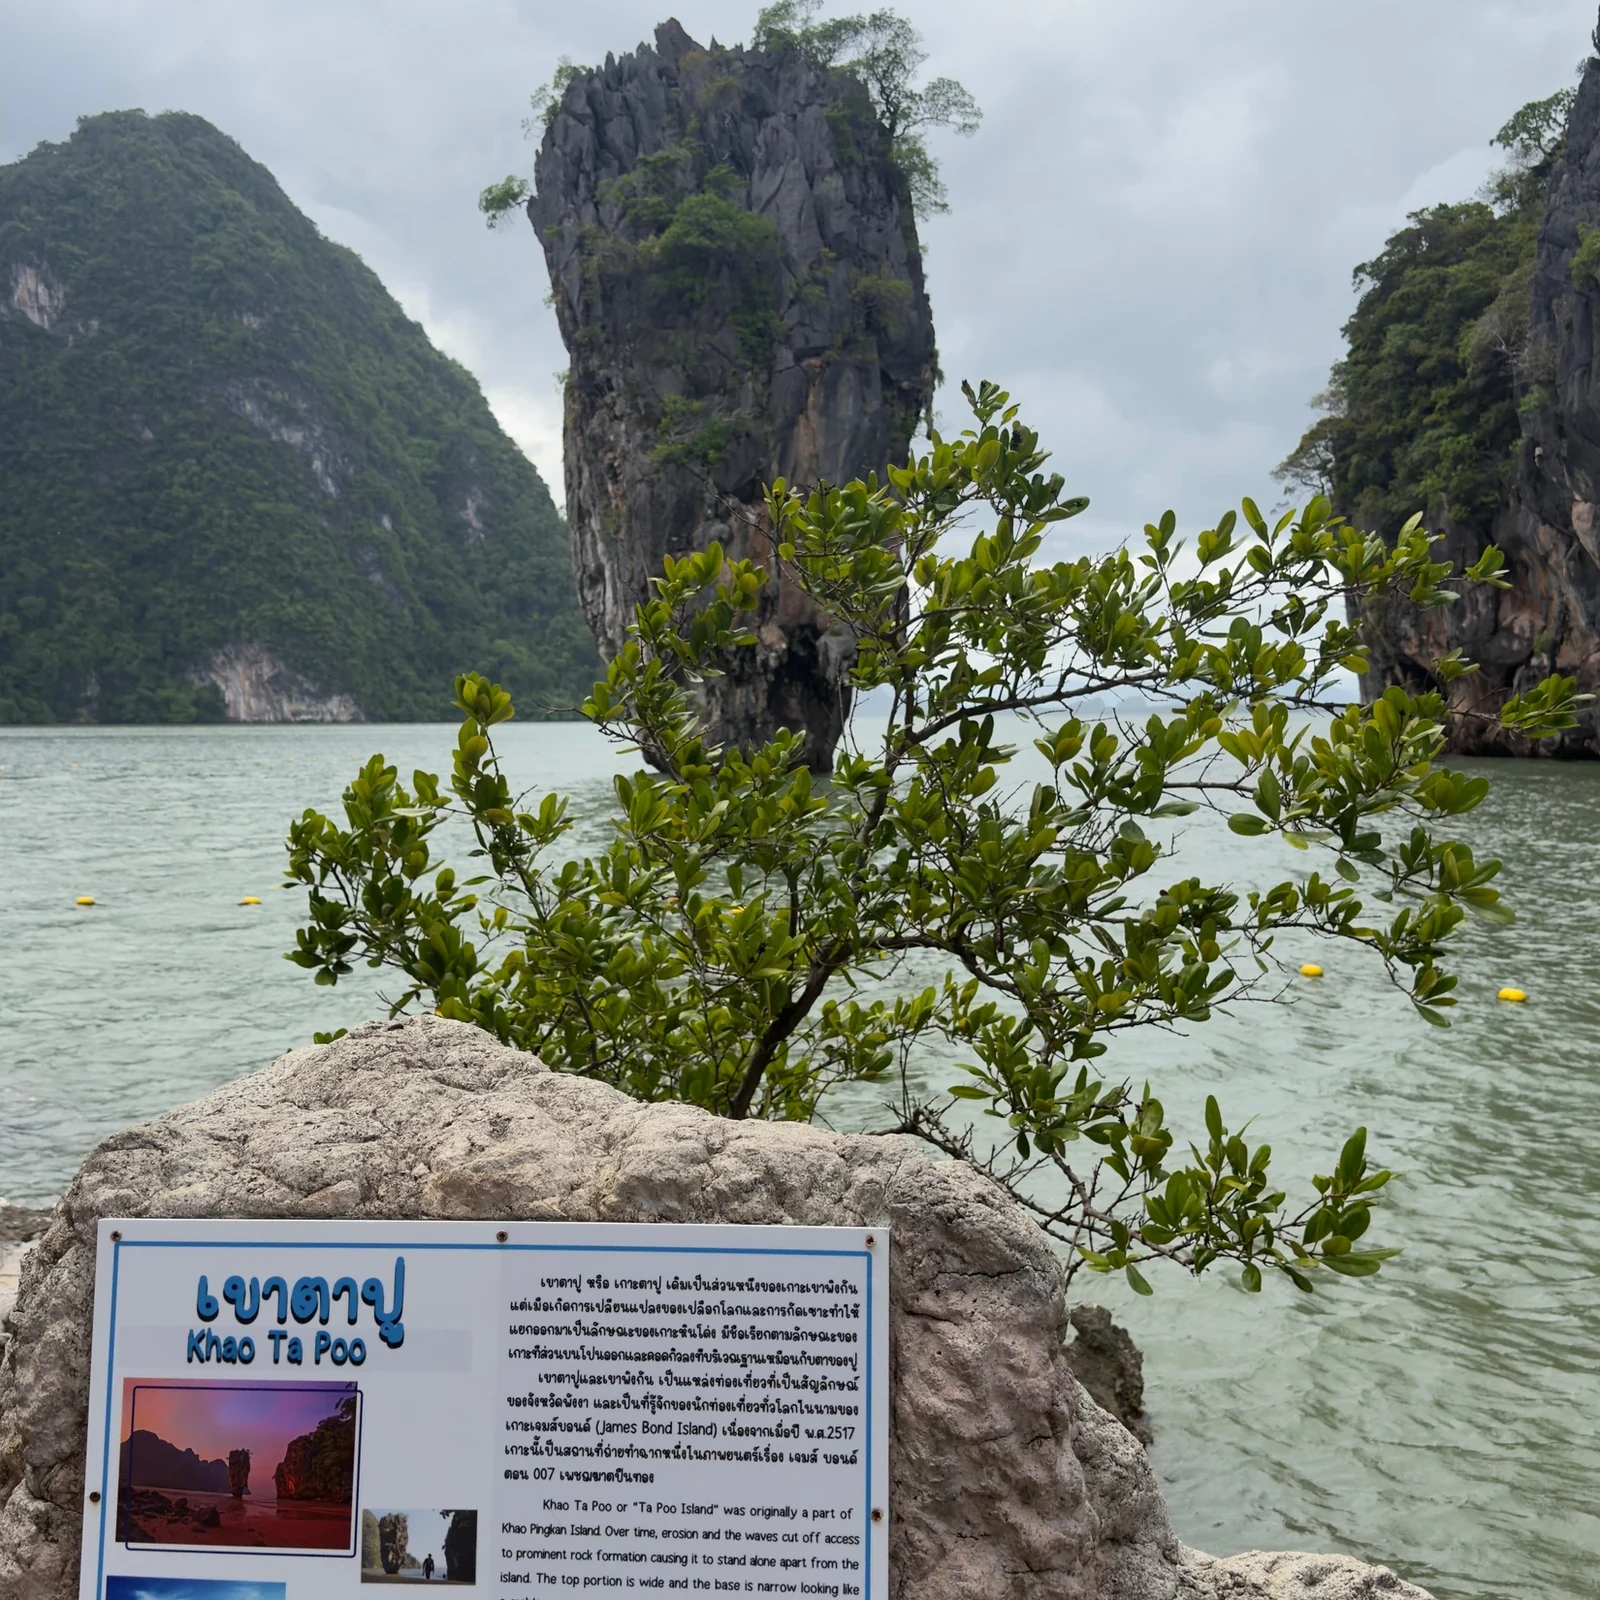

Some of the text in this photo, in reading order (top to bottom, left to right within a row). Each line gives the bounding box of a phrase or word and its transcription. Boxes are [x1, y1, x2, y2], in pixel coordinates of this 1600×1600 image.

[540, 1273, 582, 1294] เขาตาปู
[585, 1273, 610, 1290] หรือ
[613, 1275, 662, 1296] เกาะตาปู
[197, 1256, 405, 1349] เขาตาปู
[187, 1327, 366, 1366] Khao Ta Poo
[595, 1419, 638, 1436] (James
[641, 1419, 673, 1435] Bond
[676, 1421, 718, 1439] Island)
[804, 1425, 856, 1441] พ.ศ.2517
[788, 1447, 820, 1464] เจมส์
[822, 1448, 860, 1466] บอนด์
[503, 1468, 530, 1481] ตอน
[532, 1466, 556, 1481] 007
[542, 1498, 570, 1512] Khao
[573, 1499, 589, 1512] Ta
[591, 1499, 613, 1513] Poo
[615, 1503, 629, 1513] or
[656, 1501, 678, 1515] Poo
[722, 1506, 746, 1517] was
[749, 1505, 798, 1521] originally
[801, 1508, 809, 1519] a
[811, 1508, 836, 1522] part
[839, 1507, 854, 1520] of
[501, 1521, 528, 1535] Khao
[529, 1522, 568, 1539] Pingkan
[604, 1524, 631, 1538] Over
[633, 1526, 659, 1540] time,
[661, 1527, 699, 1540] erosion
[701, 1528, 721, 1541] and
[723, 1528, 742, 1542] the
[744, 1532, 779, 1543] waves
[781, 1532, 800, 1543] cut
[801, 1531, 822, 1544] off
[824, 1534, 861, 1546] access
[501, 1547, 860, 1571] to prominent rock formation causing it to stand alone apart from the
[535, 1572, 558, 1585] The
[560, 1574, 581, 1589] top
[583, 1575, 623, 1589] portion
[625, 1575, 636, 1588] is
[638, 1575, 665, 1589] wide
[668, 1577, 689, 1590] and
[692, 1577, 712, 1591] the
[714, 1578, 741, 1592] base
[744, 1579, 754, 1592] is
[756, 1582, 797, 1593] narrow
[800, 1581, 840, 1599] looking
[842, 1582, 861, 1596] like
